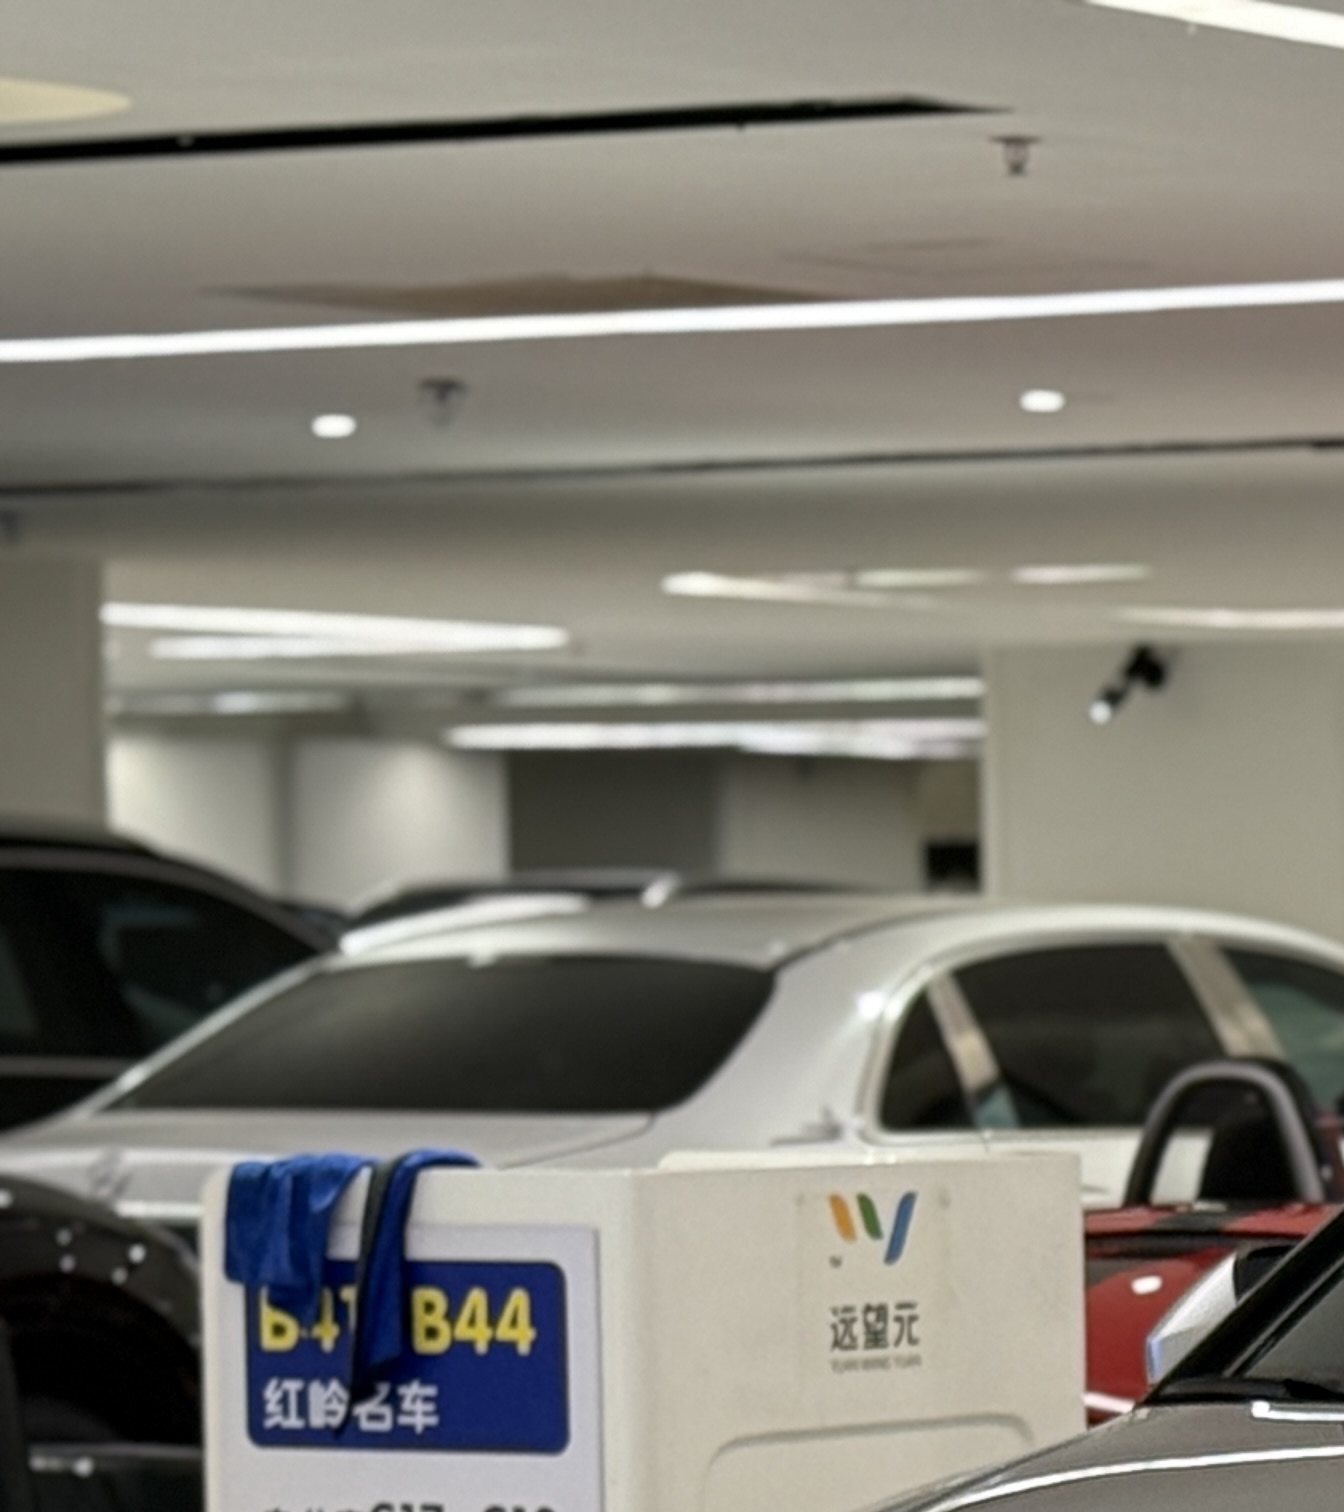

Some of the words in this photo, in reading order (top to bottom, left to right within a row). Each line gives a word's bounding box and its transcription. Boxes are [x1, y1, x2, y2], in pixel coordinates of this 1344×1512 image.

[411, 1286, 536, 1355] B44
[829, 1301, 920, 1351] 远望元
[262, 1377, 438, 1434] 红岭名车
